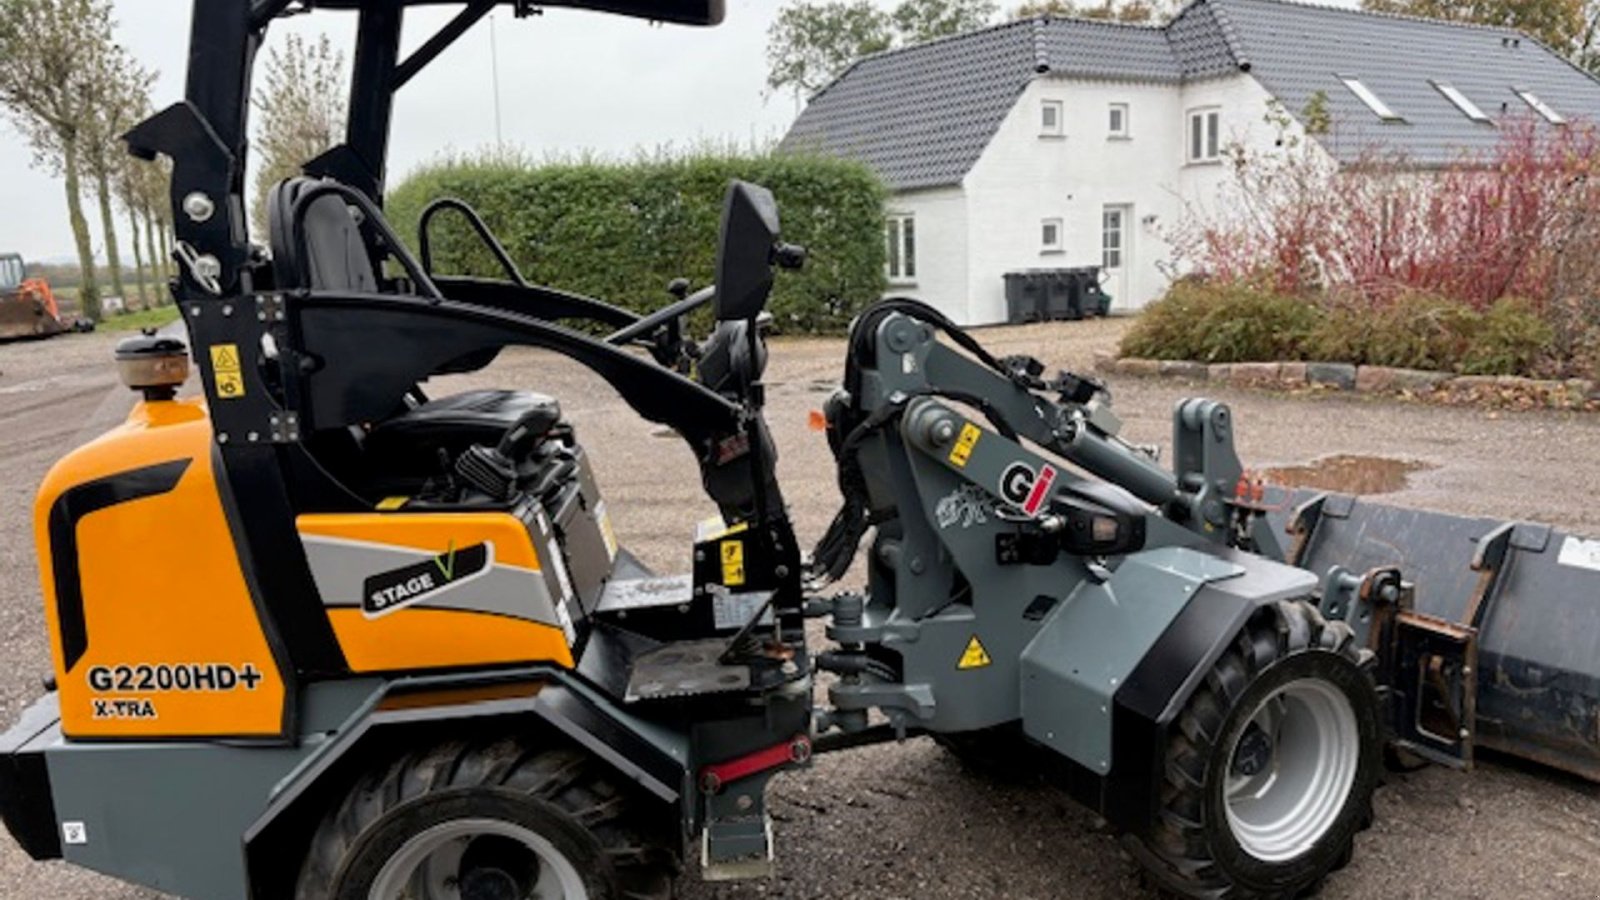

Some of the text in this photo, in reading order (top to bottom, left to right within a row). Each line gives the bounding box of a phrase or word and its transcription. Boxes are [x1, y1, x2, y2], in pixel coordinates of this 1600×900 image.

[1002, 464, 1056, 516] Gi
[371, 572, 435, 607] STAGE
[88, 664, 262, 691] G2200HD+
[94, 700, 156, 717] X-TRA
